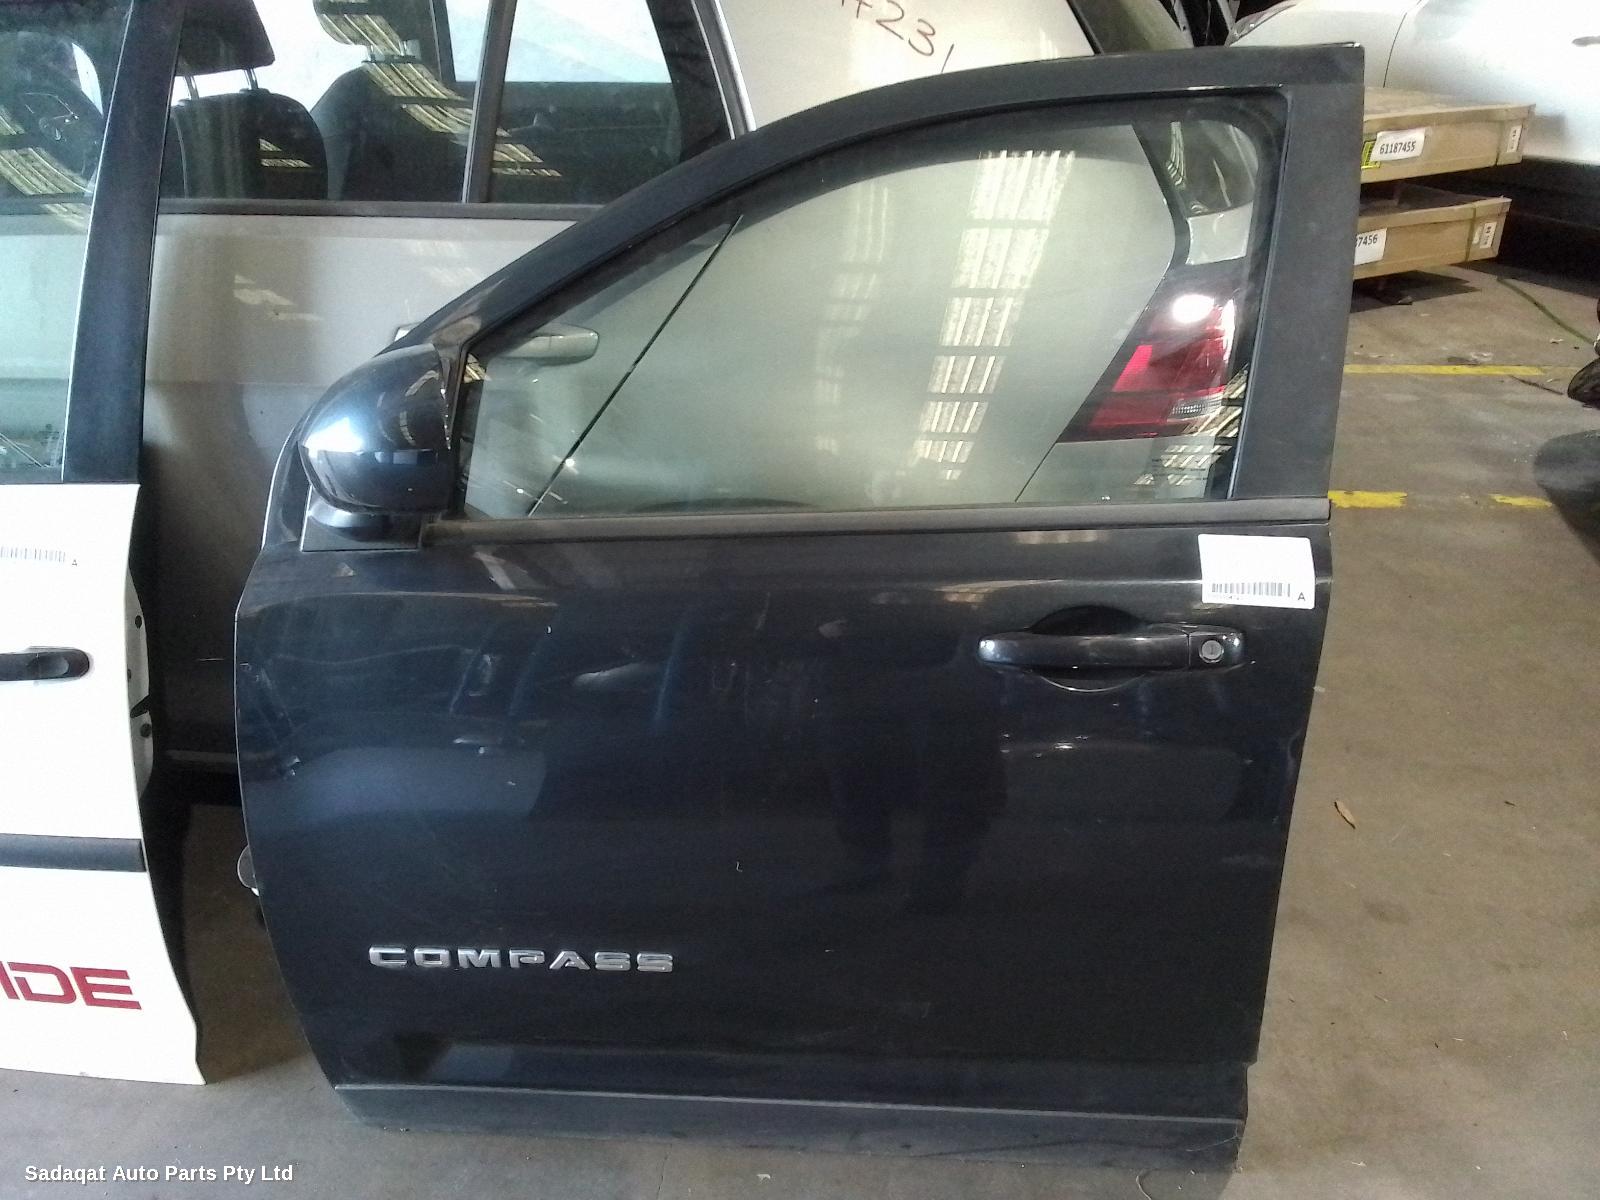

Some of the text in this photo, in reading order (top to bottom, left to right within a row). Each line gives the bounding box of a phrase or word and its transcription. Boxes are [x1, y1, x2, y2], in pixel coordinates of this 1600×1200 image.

[1380, 141, 1417, 154] 61187455
[1356, 233, 1379, 248] 7456
[1297, 592, 1306, 602] A
[369, 946, 674, 973] COMPASS
